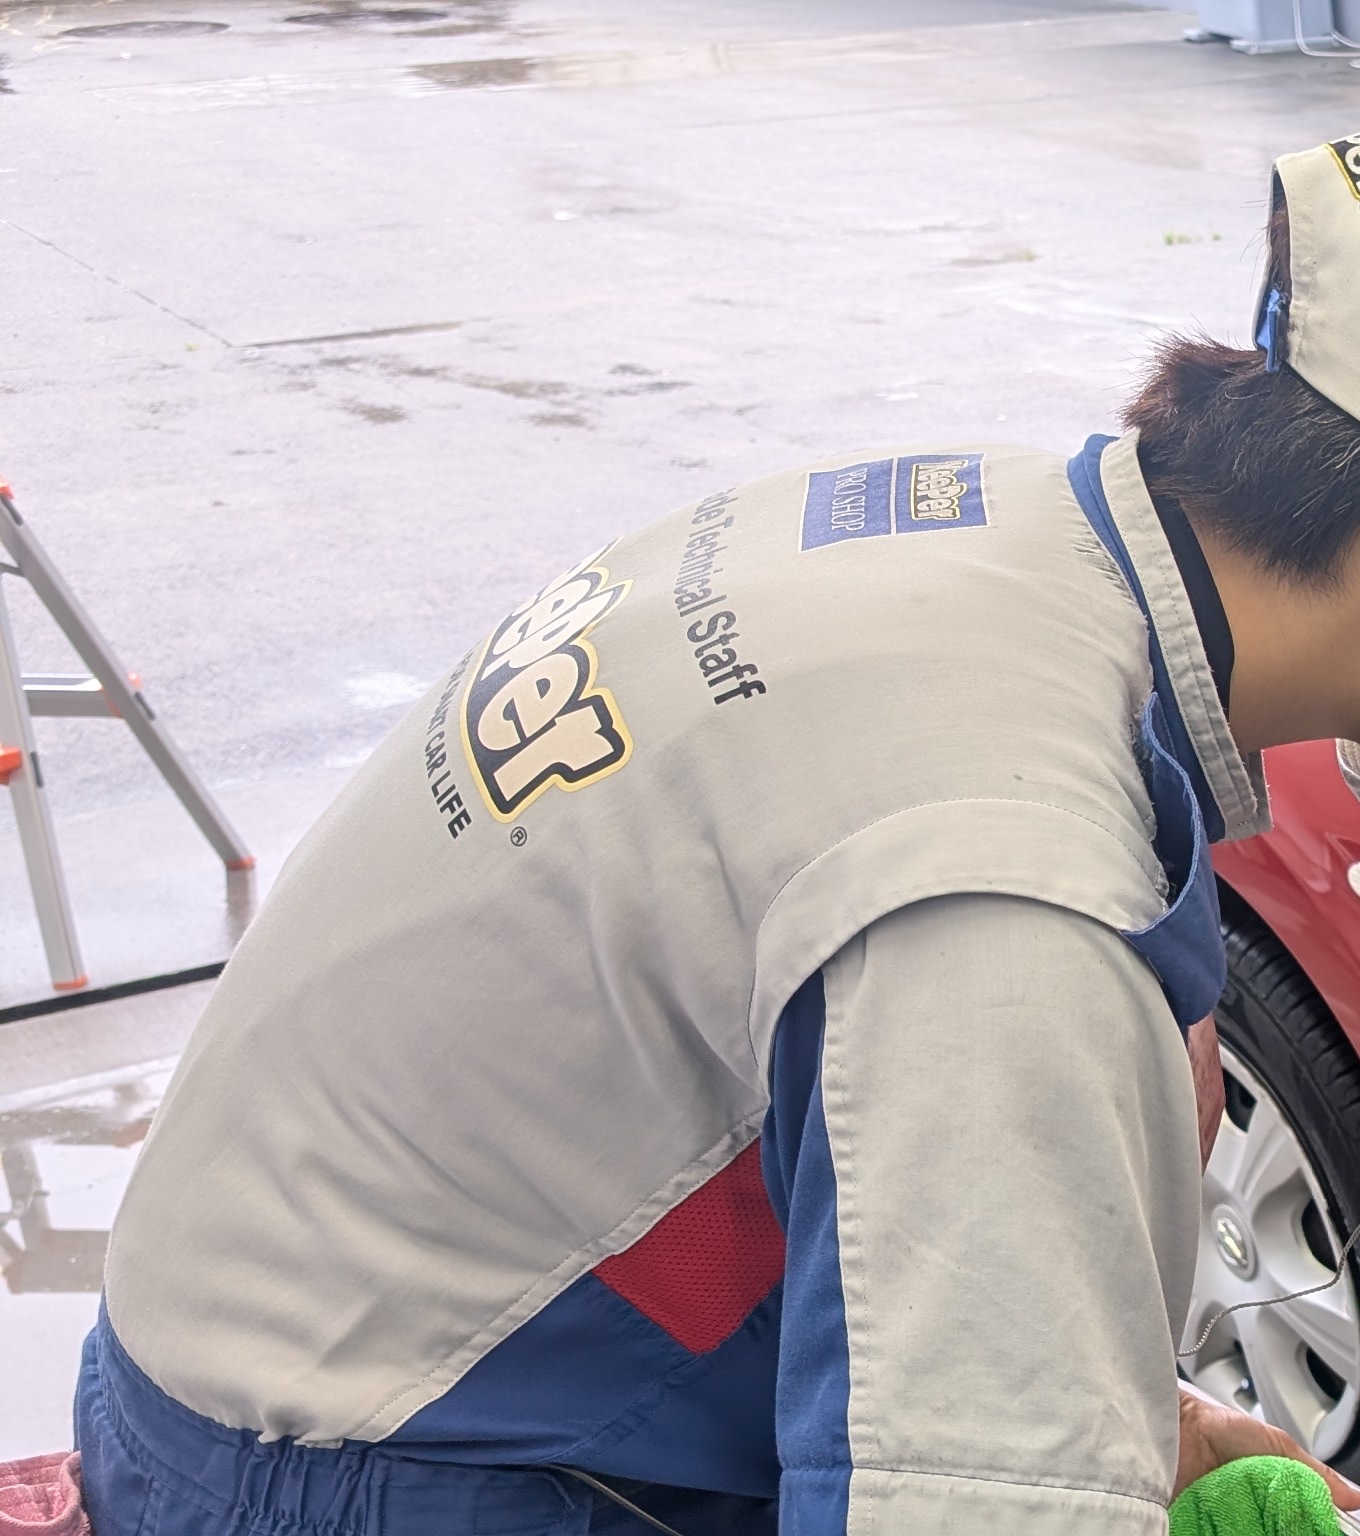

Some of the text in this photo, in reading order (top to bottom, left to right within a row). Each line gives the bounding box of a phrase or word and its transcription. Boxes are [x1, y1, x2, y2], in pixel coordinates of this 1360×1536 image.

[831, 467, 869, 531] PRO SHOP
[673, 515, 735, 617] Technical
[686, 610, 767, 705] Staff
[425, 730, 447, 779] CAR
[431, 770, 472, 839] LIFE
